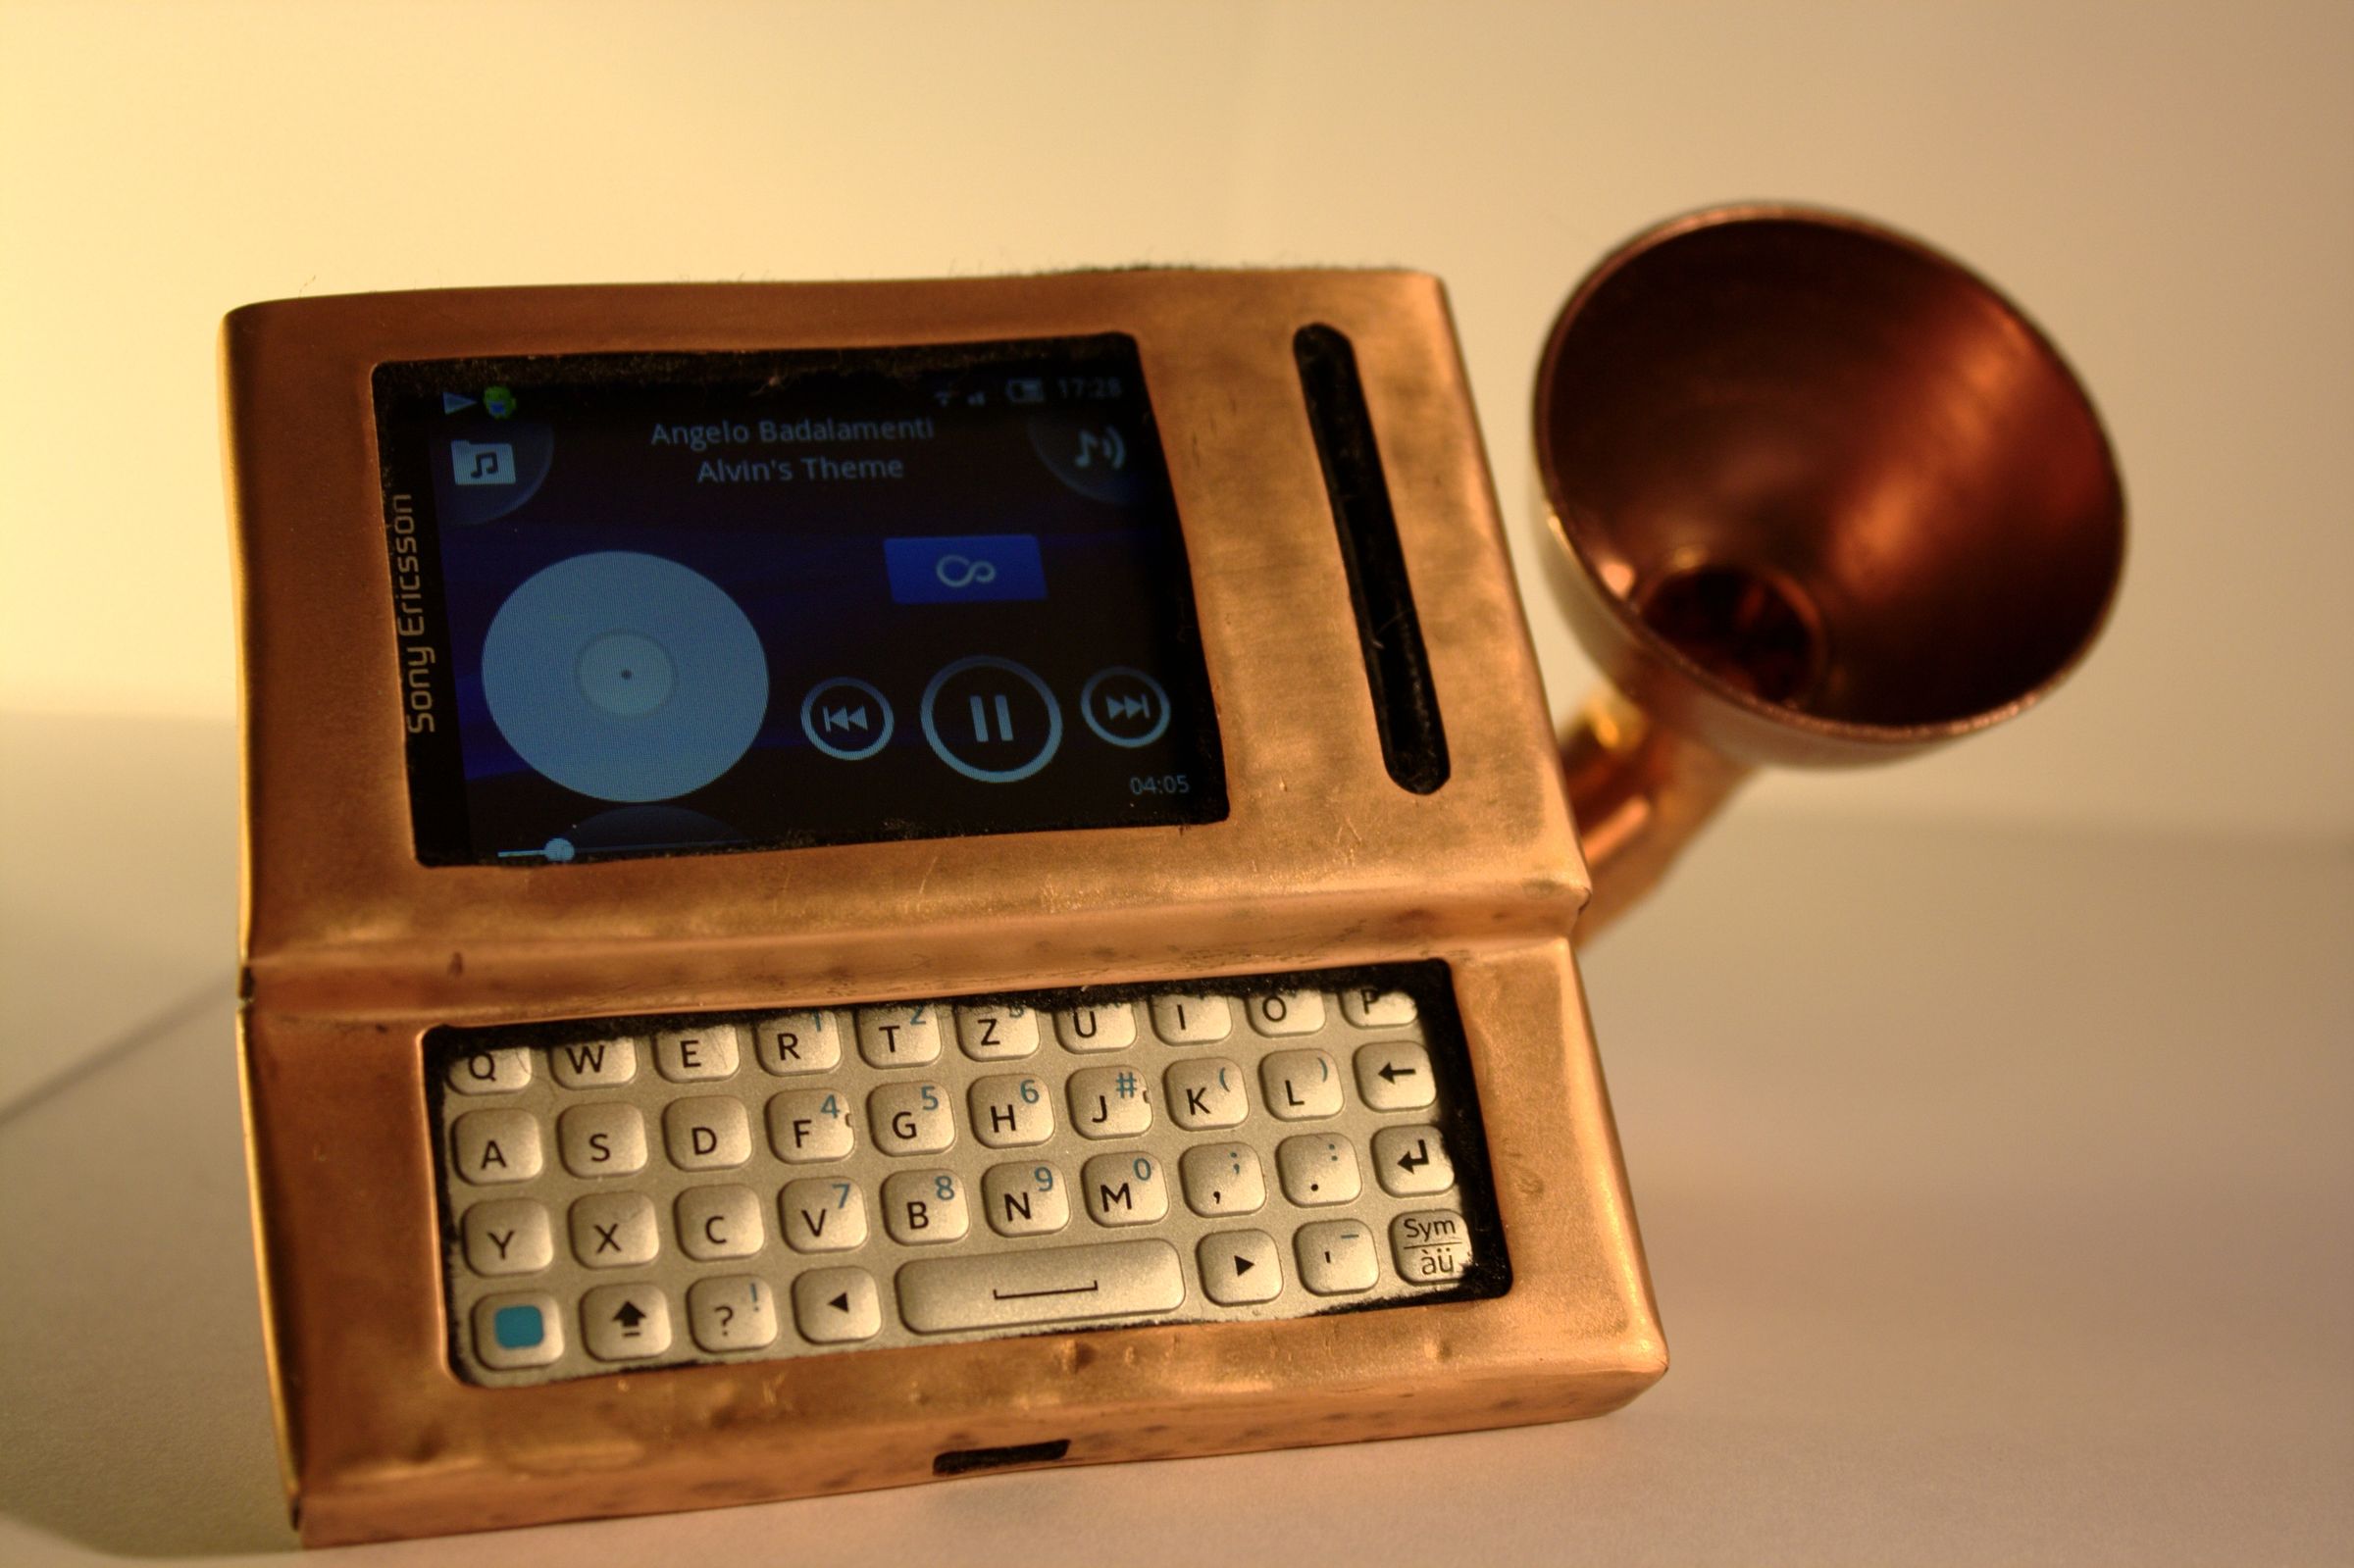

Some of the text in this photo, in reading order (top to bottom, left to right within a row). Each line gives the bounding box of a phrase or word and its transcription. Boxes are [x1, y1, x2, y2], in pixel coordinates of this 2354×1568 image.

[650, 417, 935, 449] Angelo Badalamenti
[696, 453, 905, 484] Alvin's Theme
[395, 492, 436, 734] Sony Ericsson
[1129, 773, 1192, 797] 04:05
[1262, 996, 1287, 1022] O
[980, 1019, 1000, 1046] Z
[1073, 1011, 1098, 1038] U
[779, 1033, 800, 1060] R
[878, 1026, 901, 1053] T
[565, 1045, 605, 1074] W
[682, 1040, 700, 1067] E
[922, 1087, 939, 1111] 5
[1020, 1080, 1040, 1103] 6
[1188, 1087, 1210, 1115] K
[1285, 1080, 1305, 1107] L
[820, 1094, 841, 1118] 4
[992, 1104, 1017, 1133] H
[1093, 1095, 1108, 1123] J
[793, 1120, 811, 1147] F
[892, 1112, 917, 1139] G
[589, 1134, 610, 1162] S
[693, 1127, 717, 1154] D
[481, 1140, 506, 1169] A
[936, 1176, 954, 1200] 8
[1035, 1167, 1053, 1191] 9
[832, 1184, 850, 1209] 7
[1004, 1193, 1031, 1221] N
[1100, 1184, 1132, 1211] M
[800, 1209, 828, 1237] V
[908, 1201, 929, 1229] B
[595, 1224, 622, 1252] X
[705, 1216, 725, 1244] C
[1404, 1218, 1456, 1241] Sym
[487, 1231, 515, 1259] Y
[1421, 1248, 1455, 1275] àü
[714, 1306, 734, 1335] ?
